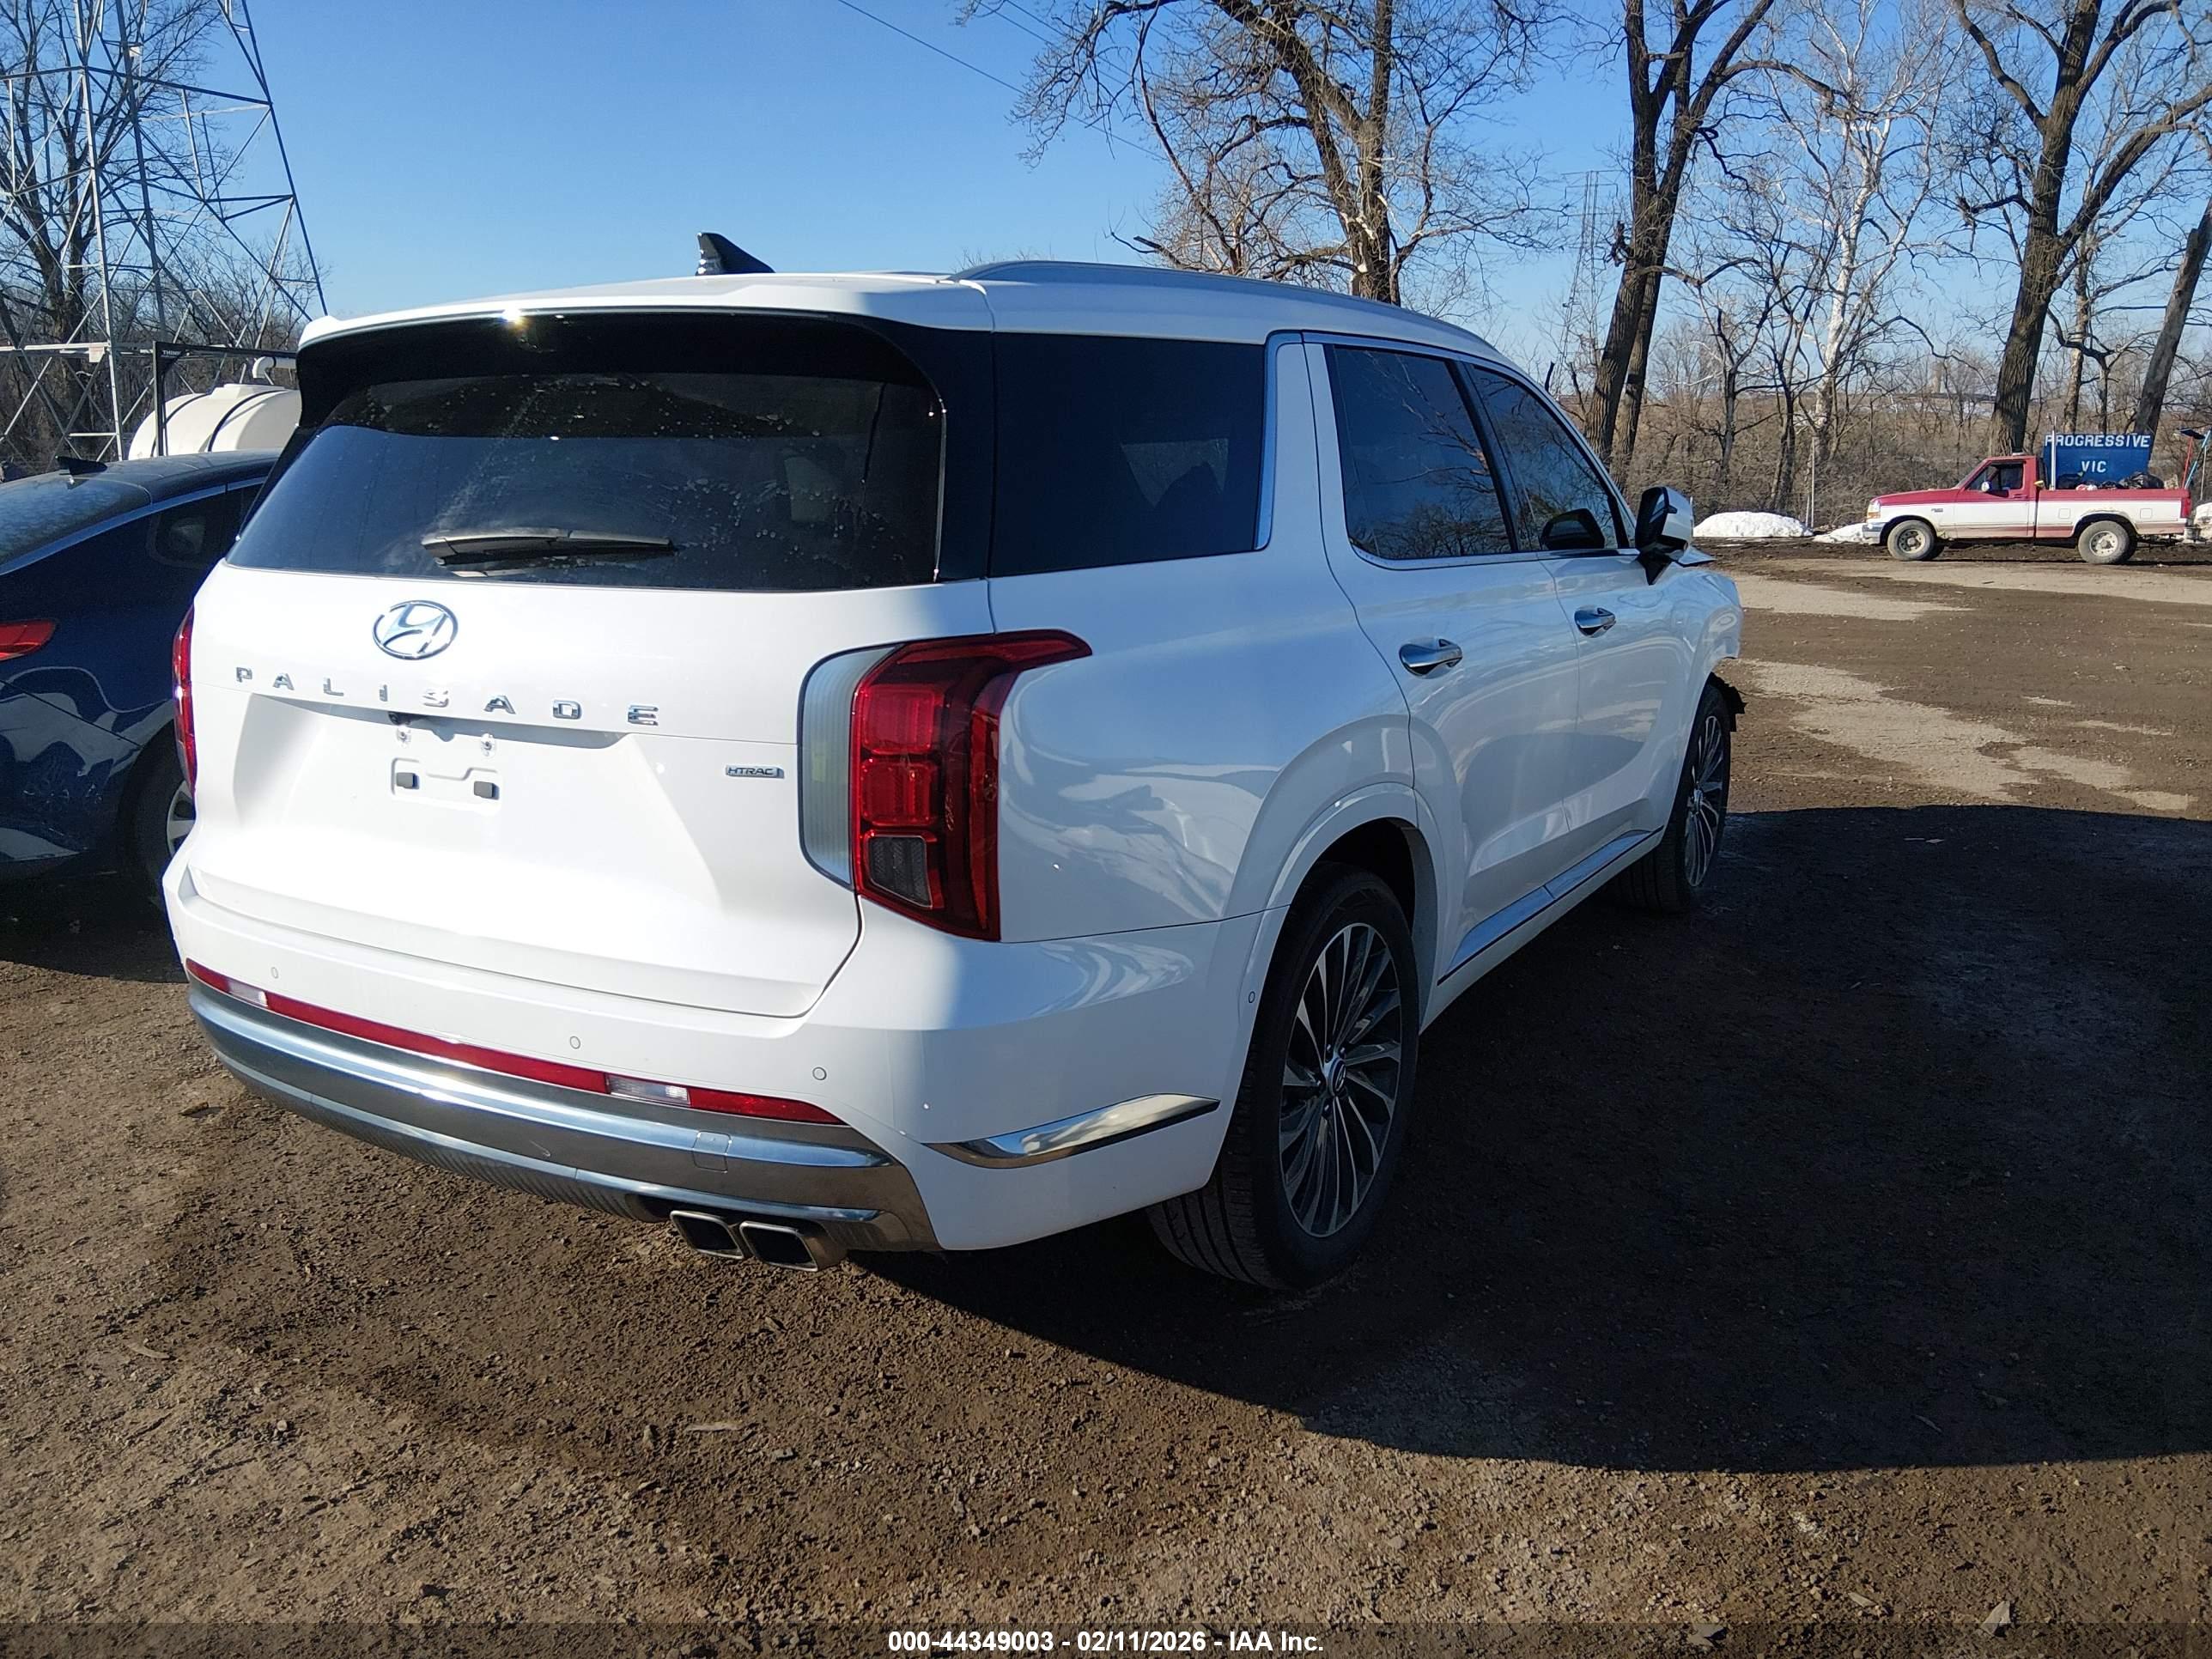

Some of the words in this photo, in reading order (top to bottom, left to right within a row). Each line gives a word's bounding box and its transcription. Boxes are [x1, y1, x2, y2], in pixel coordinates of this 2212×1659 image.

[2045, 434, 2151, 447] PROGRESSIVE
[2081, 460, 2107, 473] VIC
[235, 666, 659, 726] PALISADE
[726, 766, 776, 776] HTRAC
